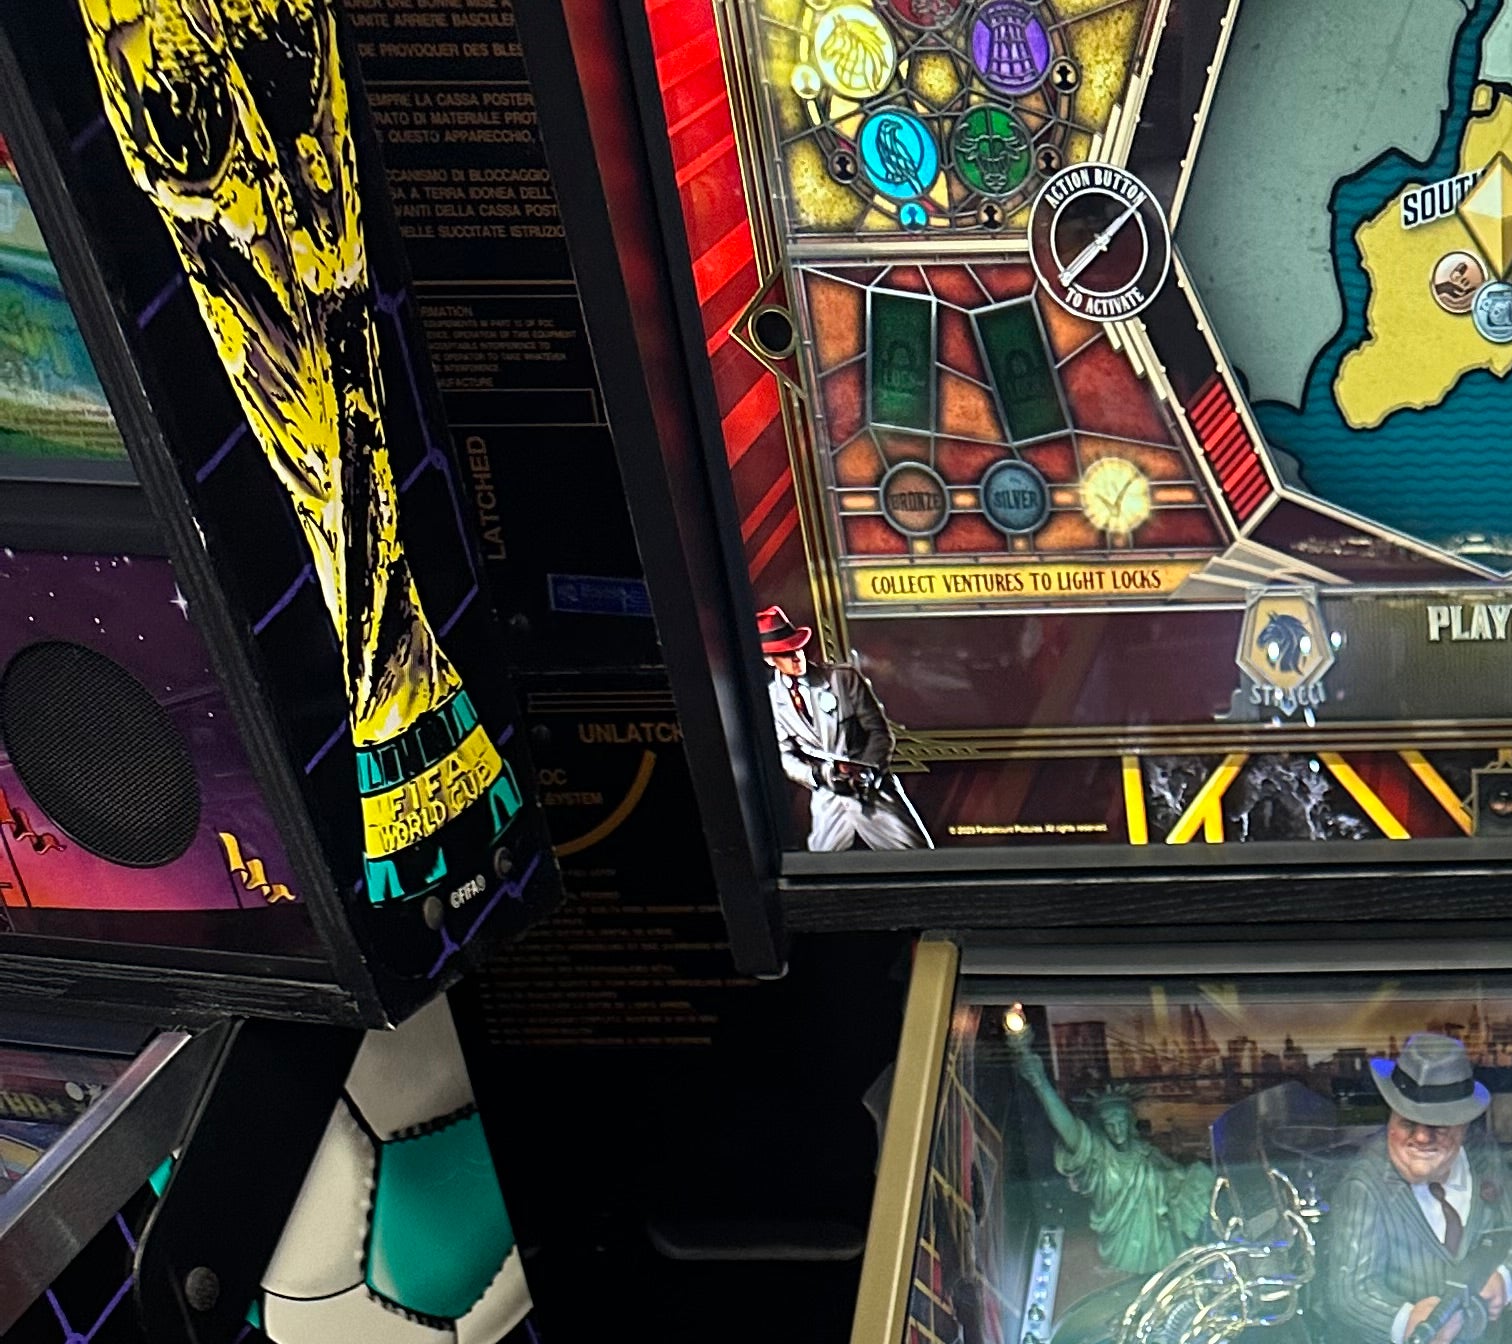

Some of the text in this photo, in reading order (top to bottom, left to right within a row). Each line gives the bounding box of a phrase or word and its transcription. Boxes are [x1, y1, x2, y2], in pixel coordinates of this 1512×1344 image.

[416, 92, 478, 106] LA CASSA
[432, 112, 500, 125] MATERIALE
[389, 130, 439, 144] QUESTO
[471, 168, 549, 182] BLOCCAGGIO
[426, 187, 515, 200] TERRA IDONEA
[1045, 169, 1147, 209] ACTION BUTTON
[435, 204, 520, 217] DELLA CASSA
[439, 225, 506, 238] SUCCITATE
[1065, 286, 1145, 315] TO ACTIVATE
[464, 435, 508, 561] LATCHED
[890, 492, 941, 511] BRONZE
[993, 490, 1037, 509] SILVER
[871, 570, 1161, 594] COLLECT VENTURES TO LIGHT LOCKS
[392, 752, 464, 821] FIFA
[380, 762, 492, 852] WORLD CUP
